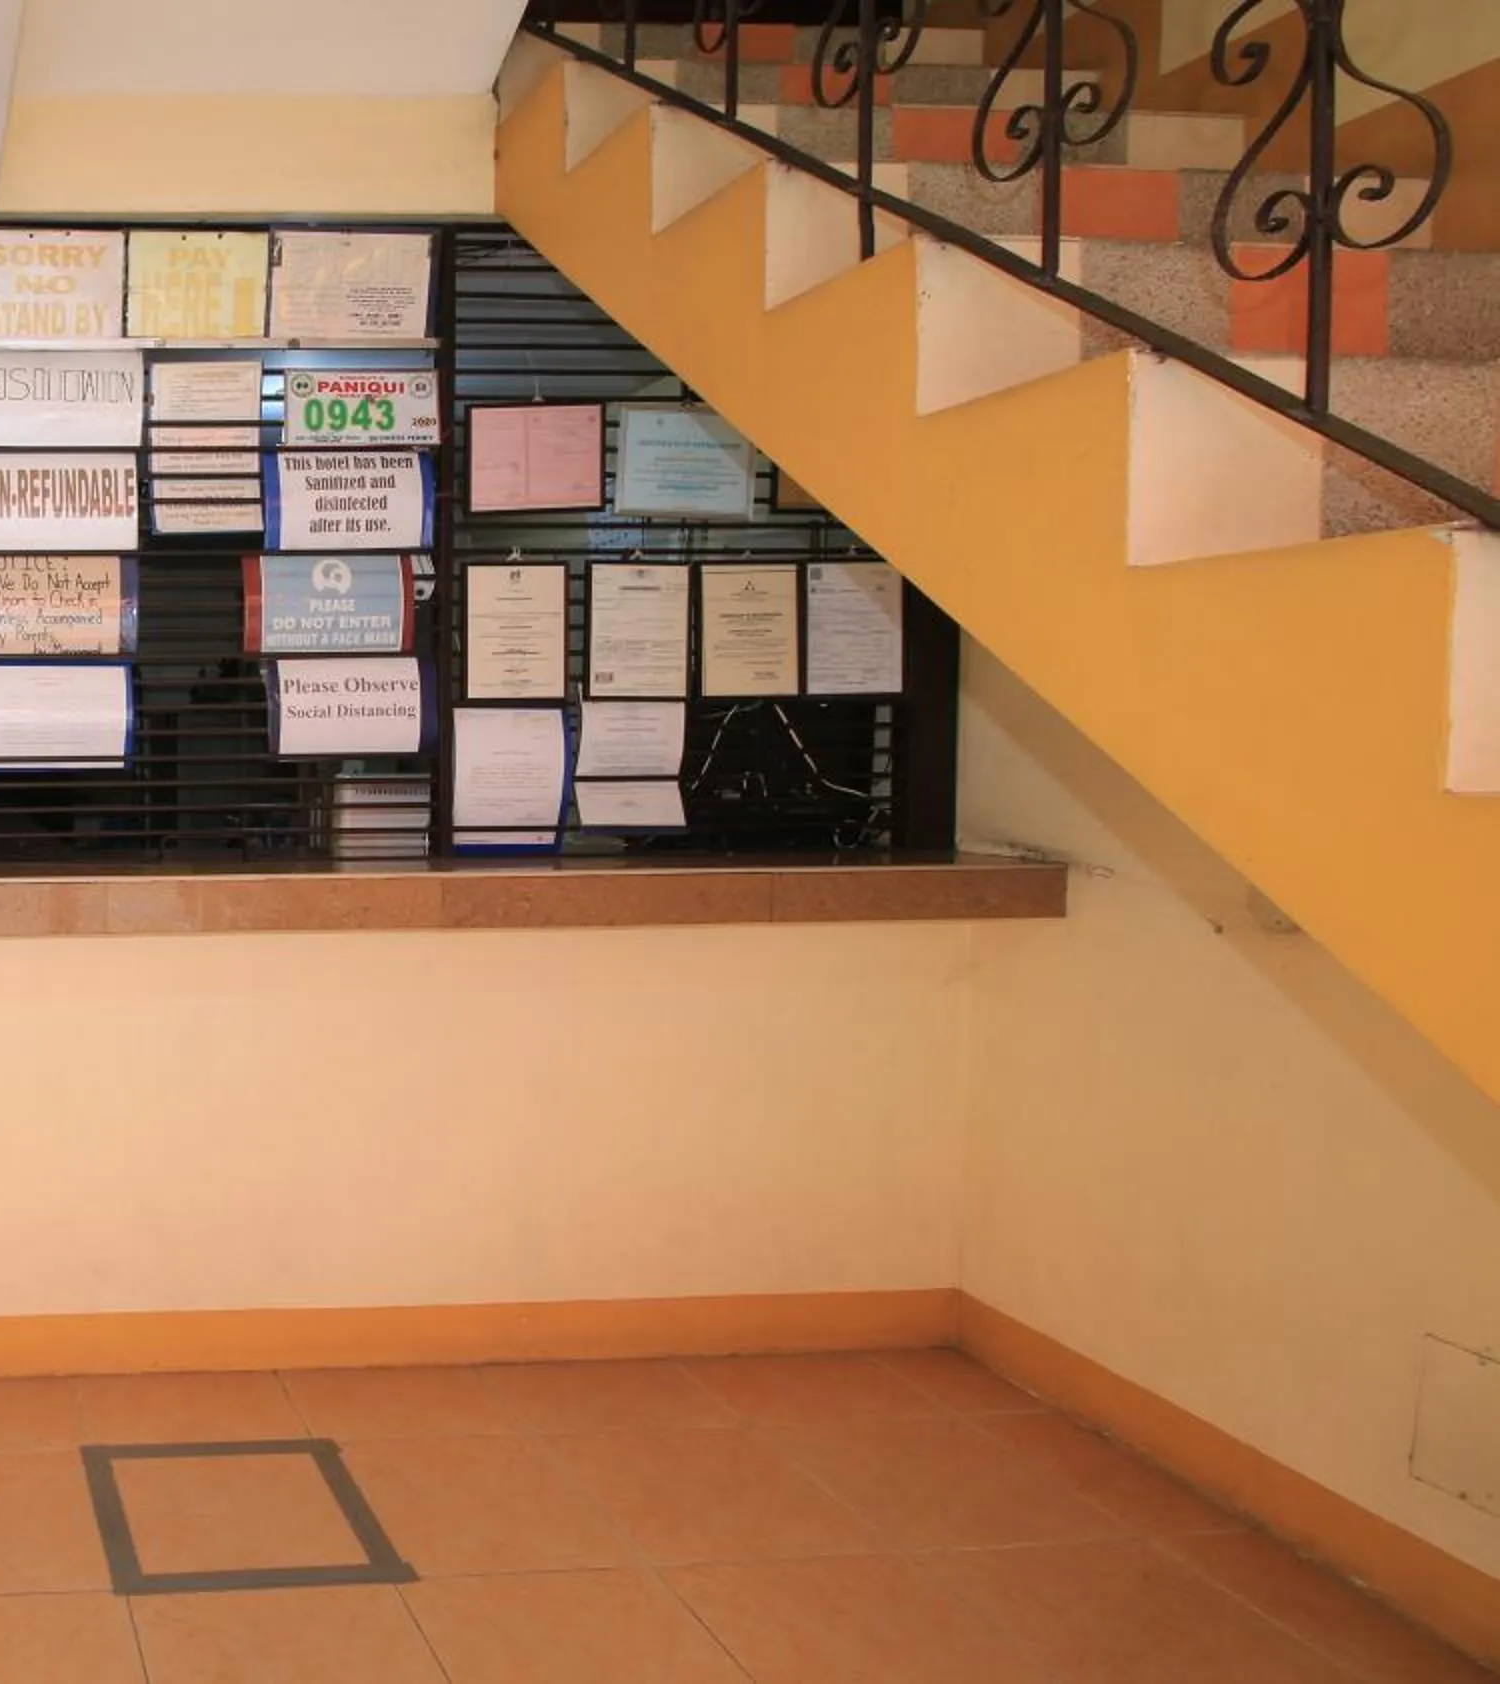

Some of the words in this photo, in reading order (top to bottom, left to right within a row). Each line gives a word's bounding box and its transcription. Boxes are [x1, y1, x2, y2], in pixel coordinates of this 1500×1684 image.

[168, 247, 232, 268] PAY
[15, 275, 78, 294] NO
[75, 302, 108, 335] BY
[317, 381, 405, 394] PANIQUI
[304, 398, 395, 431] 0943
[284, 456, 312, 471] This
[315, 456, 350, 471] hotel
[353, 456, 377, 470] has
[380, 456, 414, 469] been
[305, 475, 367, 491] Sanitized
[369, 474, 397, 489] and
[315, 495, 388, 512] disinfected
[309, 518, 342, 533] after
[345, 518, 361, 533] its
[365, 518, 391, 532] use.
[22, 573, 39, 590] Do
[47, 573, 73, 590] Not
[309, 599, 356, 613] PLEASE
[272, 617, 296, 630] DO
[301, 616, 333, 630] NOT
[339, 615, 391, 629] ENTER
[266, 632, 318, 647] WITHOUT
[321, 632, 329, 645] A
[331, 632, 361, 646] FACE
[284, 677, 340, 694] Please
[343, 676, 419, 693] Observe
[286, 705, 332, 719] Social
[337, 703, 417, 719] Distancing
